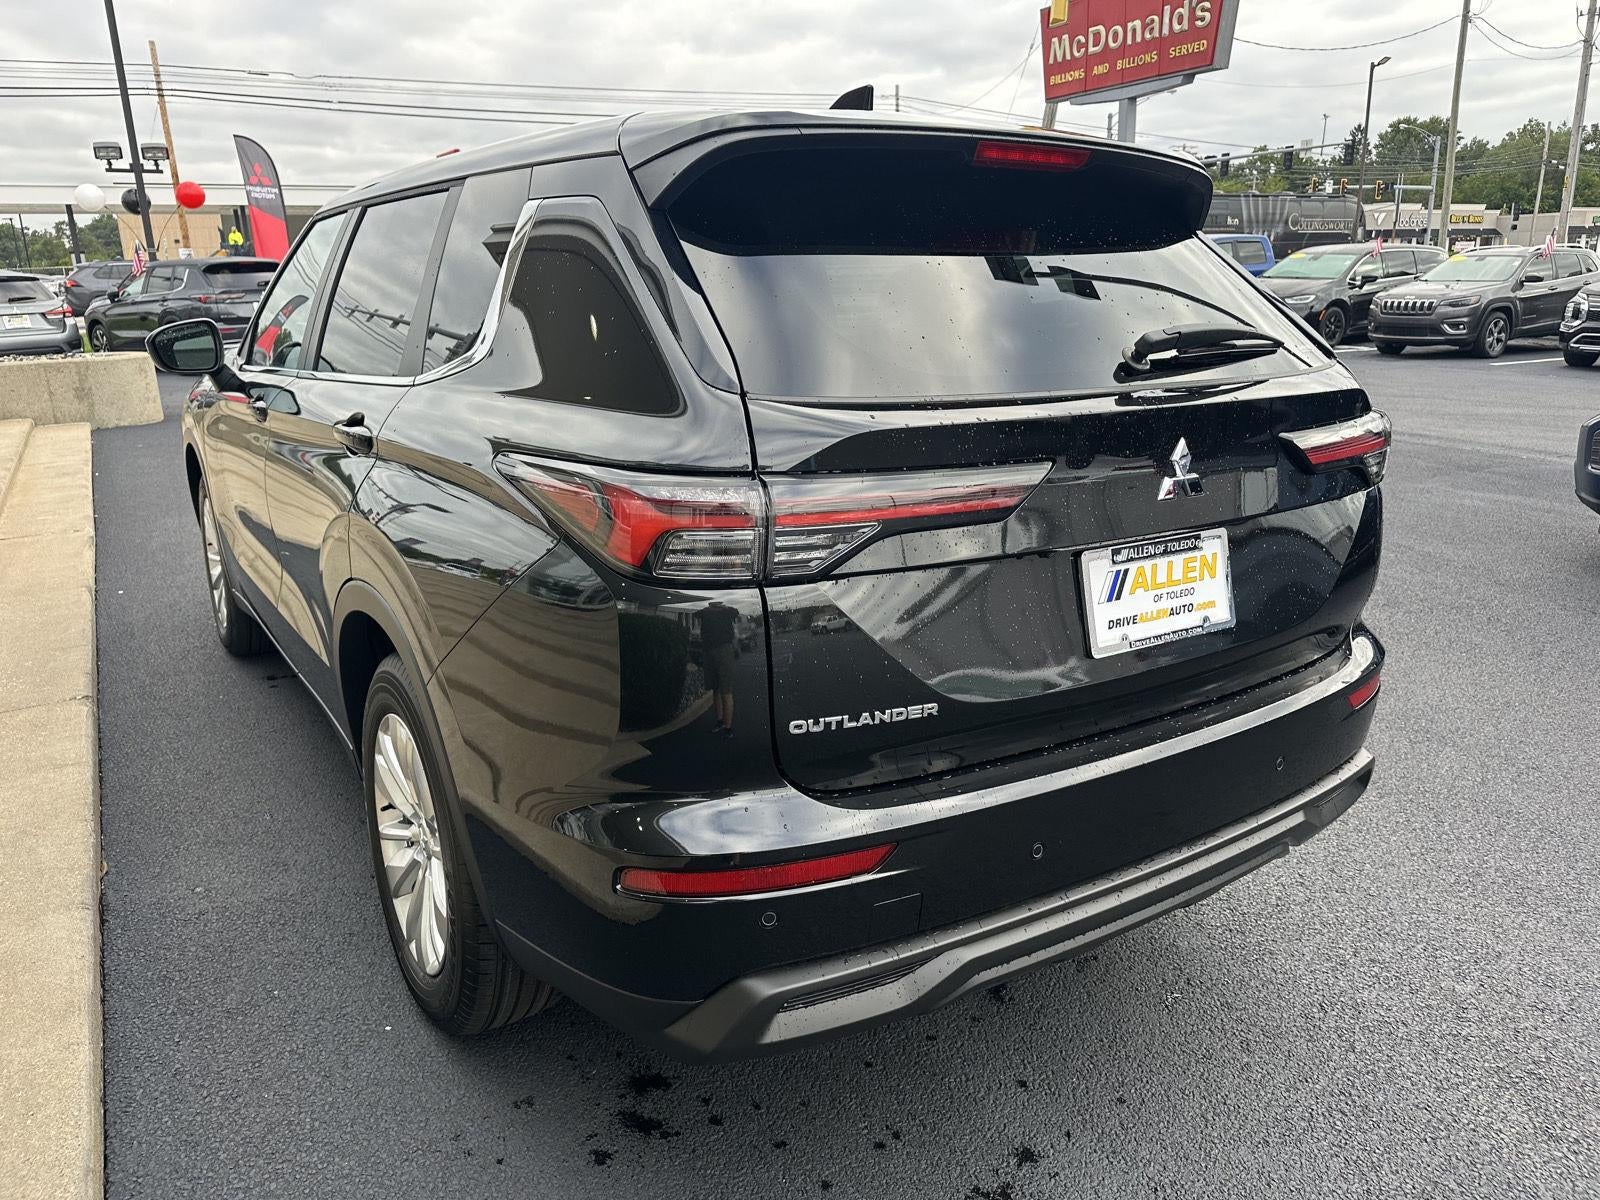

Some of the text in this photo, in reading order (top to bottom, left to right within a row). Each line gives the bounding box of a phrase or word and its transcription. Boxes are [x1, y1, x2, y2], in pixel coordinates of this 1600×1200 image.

[1049, 0, 1213, 65] McDonald's
[1050, 39, 1208, 86] BILLIONS AND BILLIONS SERVED
[1128, 539, 1196, 559] ALLEN OF TOLEDO
[1129, 552, 1217, 595] ALLEN
[1153, 587, 1195, 603] OF TOLEDO
[789, 703, 938, 734] OUTLANDER
